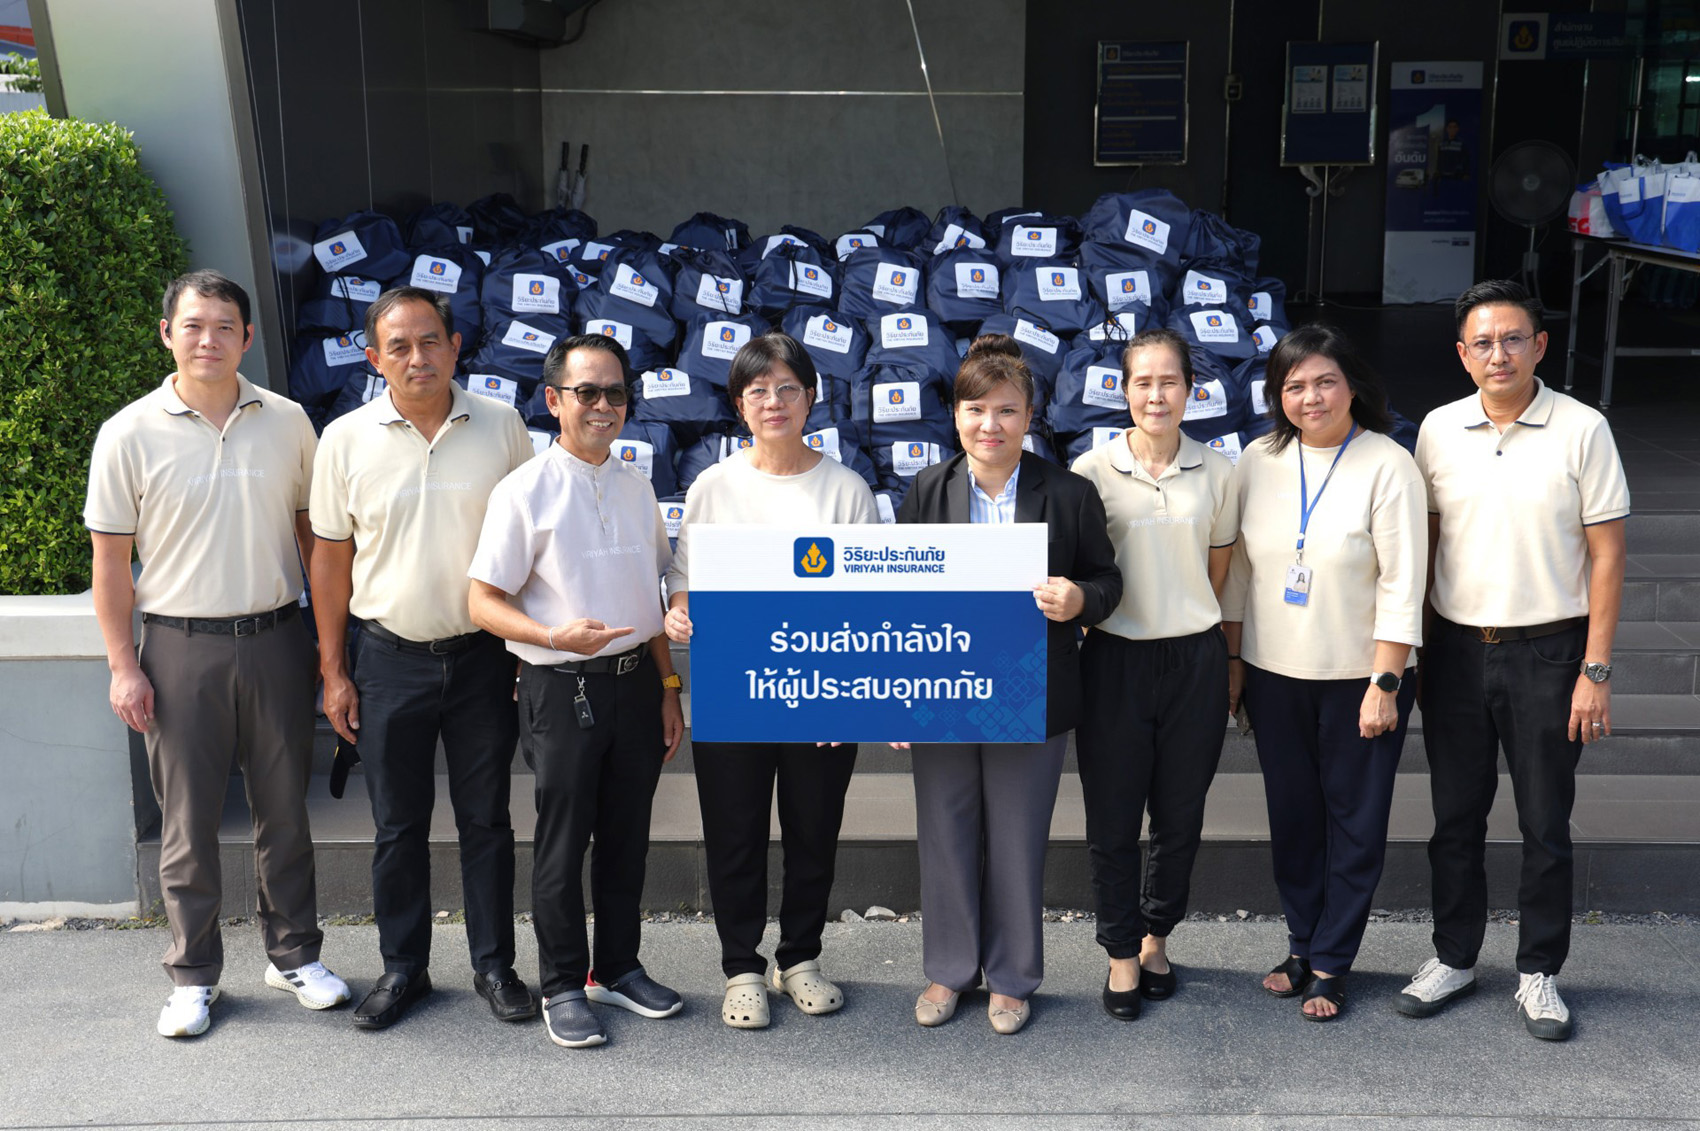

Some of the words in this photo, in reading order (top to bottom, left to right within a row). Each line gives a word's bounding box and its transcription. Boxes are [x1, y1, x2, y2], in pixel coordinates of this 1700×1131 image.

[1394, 150, 1426, 163] อันดับ
[843, 546, 945, 562] วิริยะประกันภัย
[843, 564, 884, 573] VIRIYAH
[887, 564, 945, 573] INSURANCE
[770, 621, 972, 653] ร่วมส่งกำลังใจ
[745, 667, 993, 709] ให้ผู้ประสบอุทกภัย
